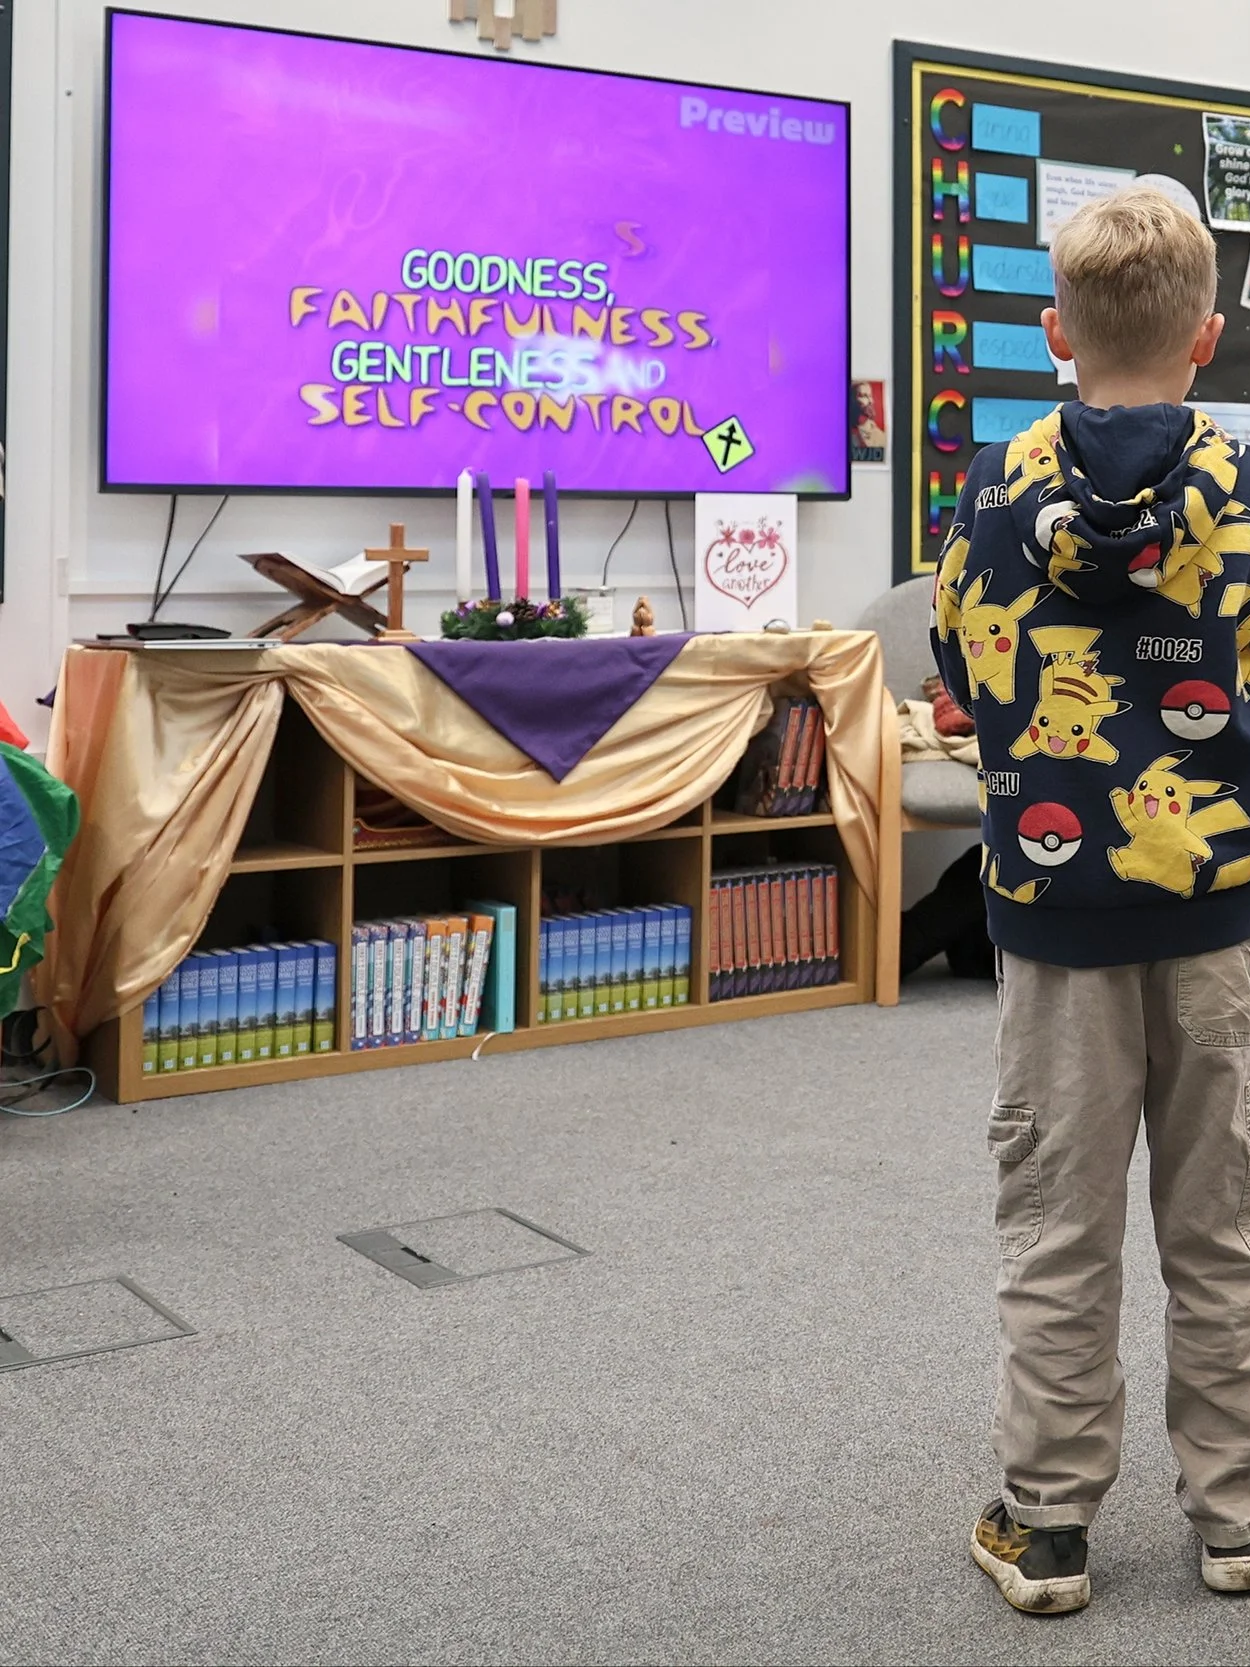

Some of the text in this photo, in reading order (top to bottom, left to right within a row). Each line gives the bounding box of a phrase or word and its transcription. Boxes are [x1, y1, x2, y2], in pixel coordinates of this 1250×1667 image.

[679, 96, 836, 146] Preview
[1215, 143, 1244, 158] Grow
[1220, 158, 1250, 171] shine
[402, 248, 615, 306] GOODNESS,
[331, 340, 597, 392] GENTLENESS
[299, 384, 706, 436] SELF-CONTROL
[713, 548, 773, 574] love
[1136, 636, 1203, 663] #0025
